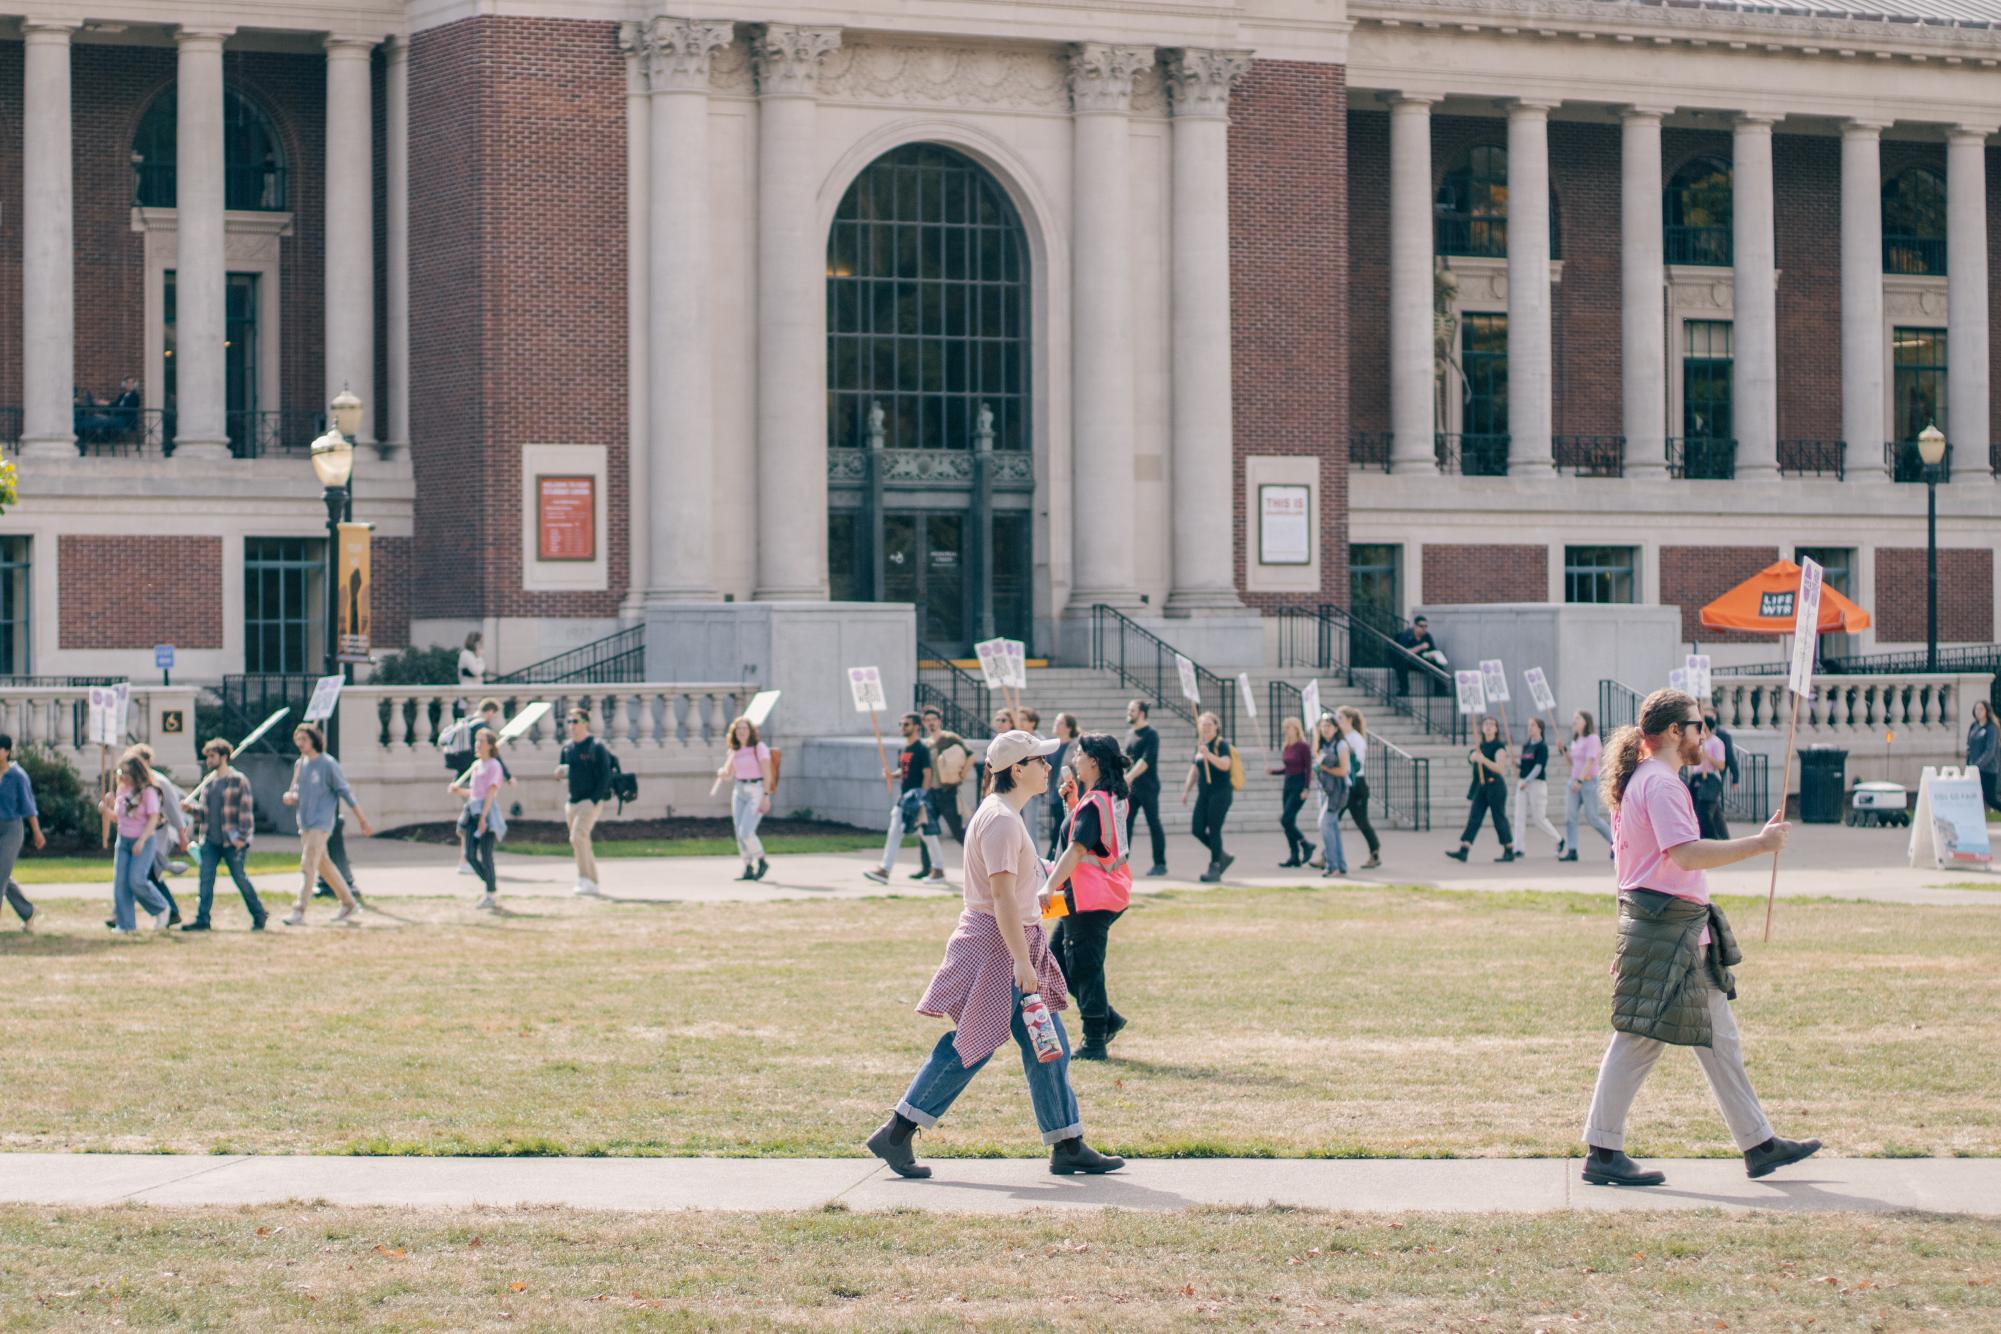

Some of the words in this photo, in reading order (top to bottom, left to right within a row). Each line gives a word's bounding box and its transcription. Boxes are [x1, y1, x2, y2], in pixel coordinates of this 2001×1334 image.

[1266, 498, 1289, 508] THIS
[1763, 594, 1793, 605] LIFE
[1762, 604, 1792, 615] WTR
